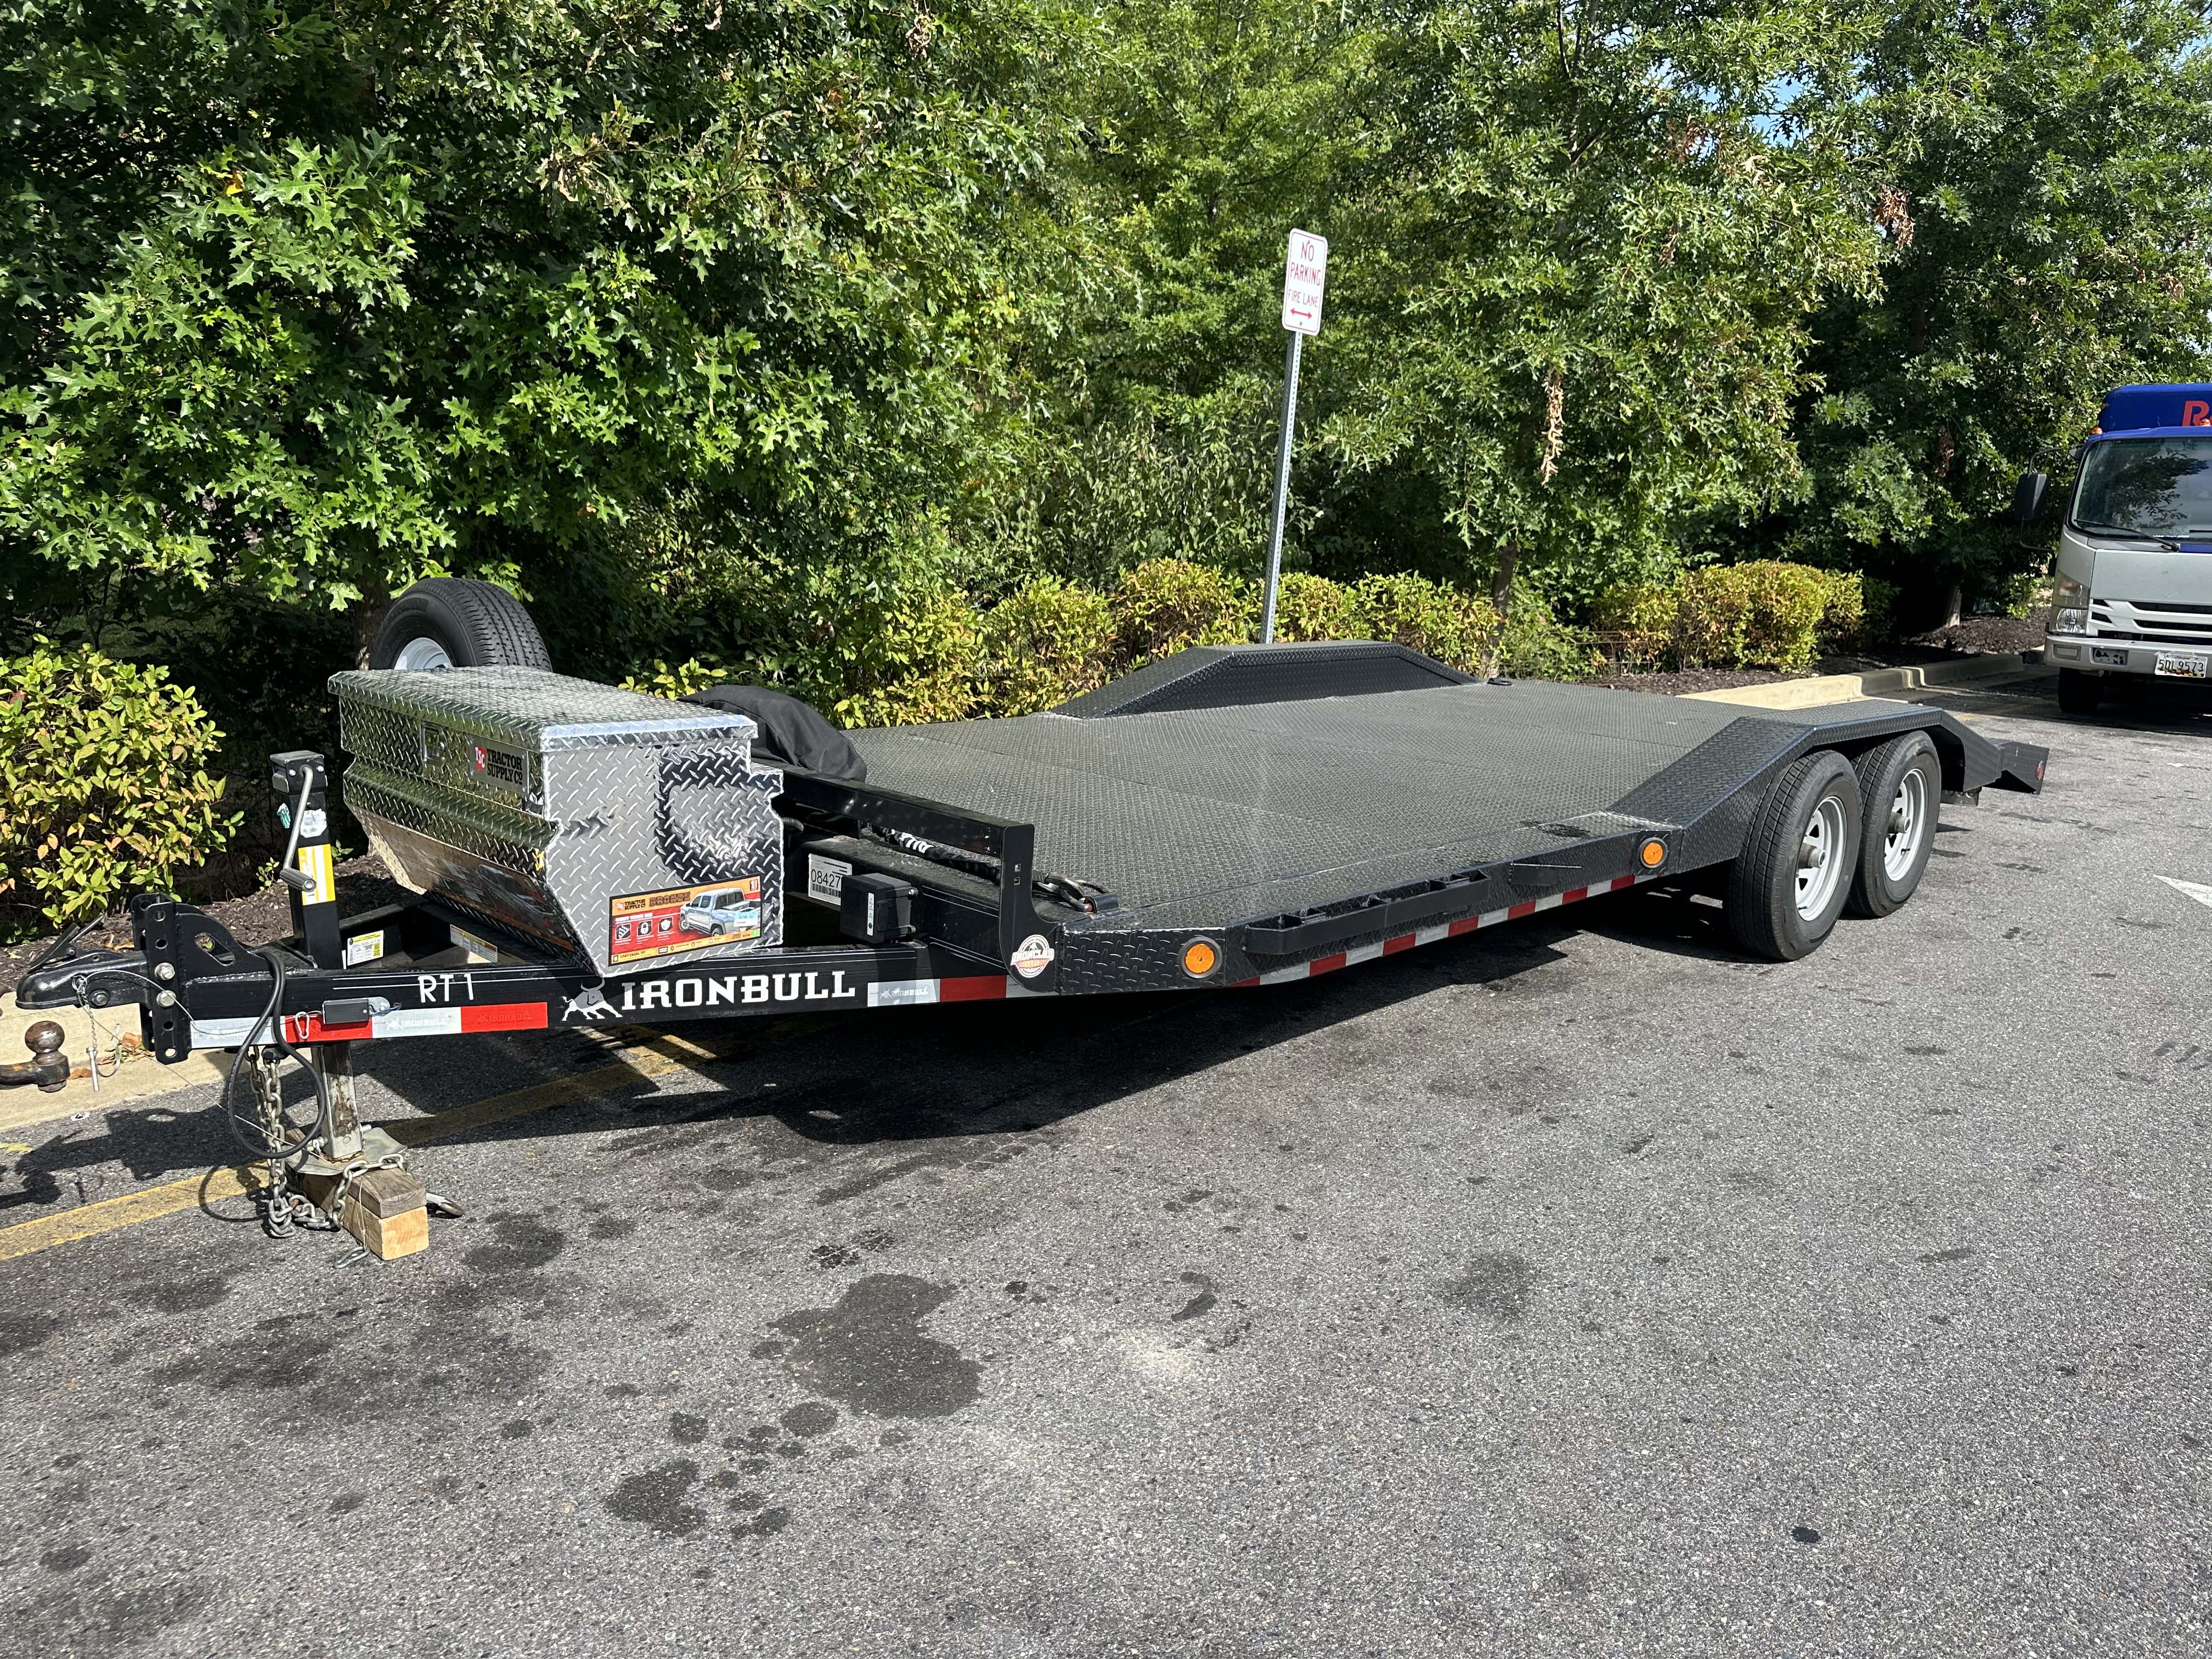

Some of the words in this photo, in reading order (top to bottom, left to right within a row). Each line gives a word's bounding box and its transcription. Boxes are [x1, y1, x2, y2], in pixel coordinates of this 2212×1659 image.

[1301, 242, 1314, 262] NO
[1290, 262, 1321, 286] PARKING
[1288, 289, 1301, 303] FIRE
[1303, 292, 1318, 308] LANE
[2158, 659, 2204, 672] 5DL9573
[475, 747, 486, 768] TSC
[487, 748, 522, 770] TRACTOR
[487, 763, 514, 782] SUPPLY
[811, 868, 841, 889] 08427
[649, 891, 691, 907] BRONZE
[417, 974, 454, 1003] RT
[464, 973, 474, 1000] 1
[622, 970, 856, 1011] IRONBULL
